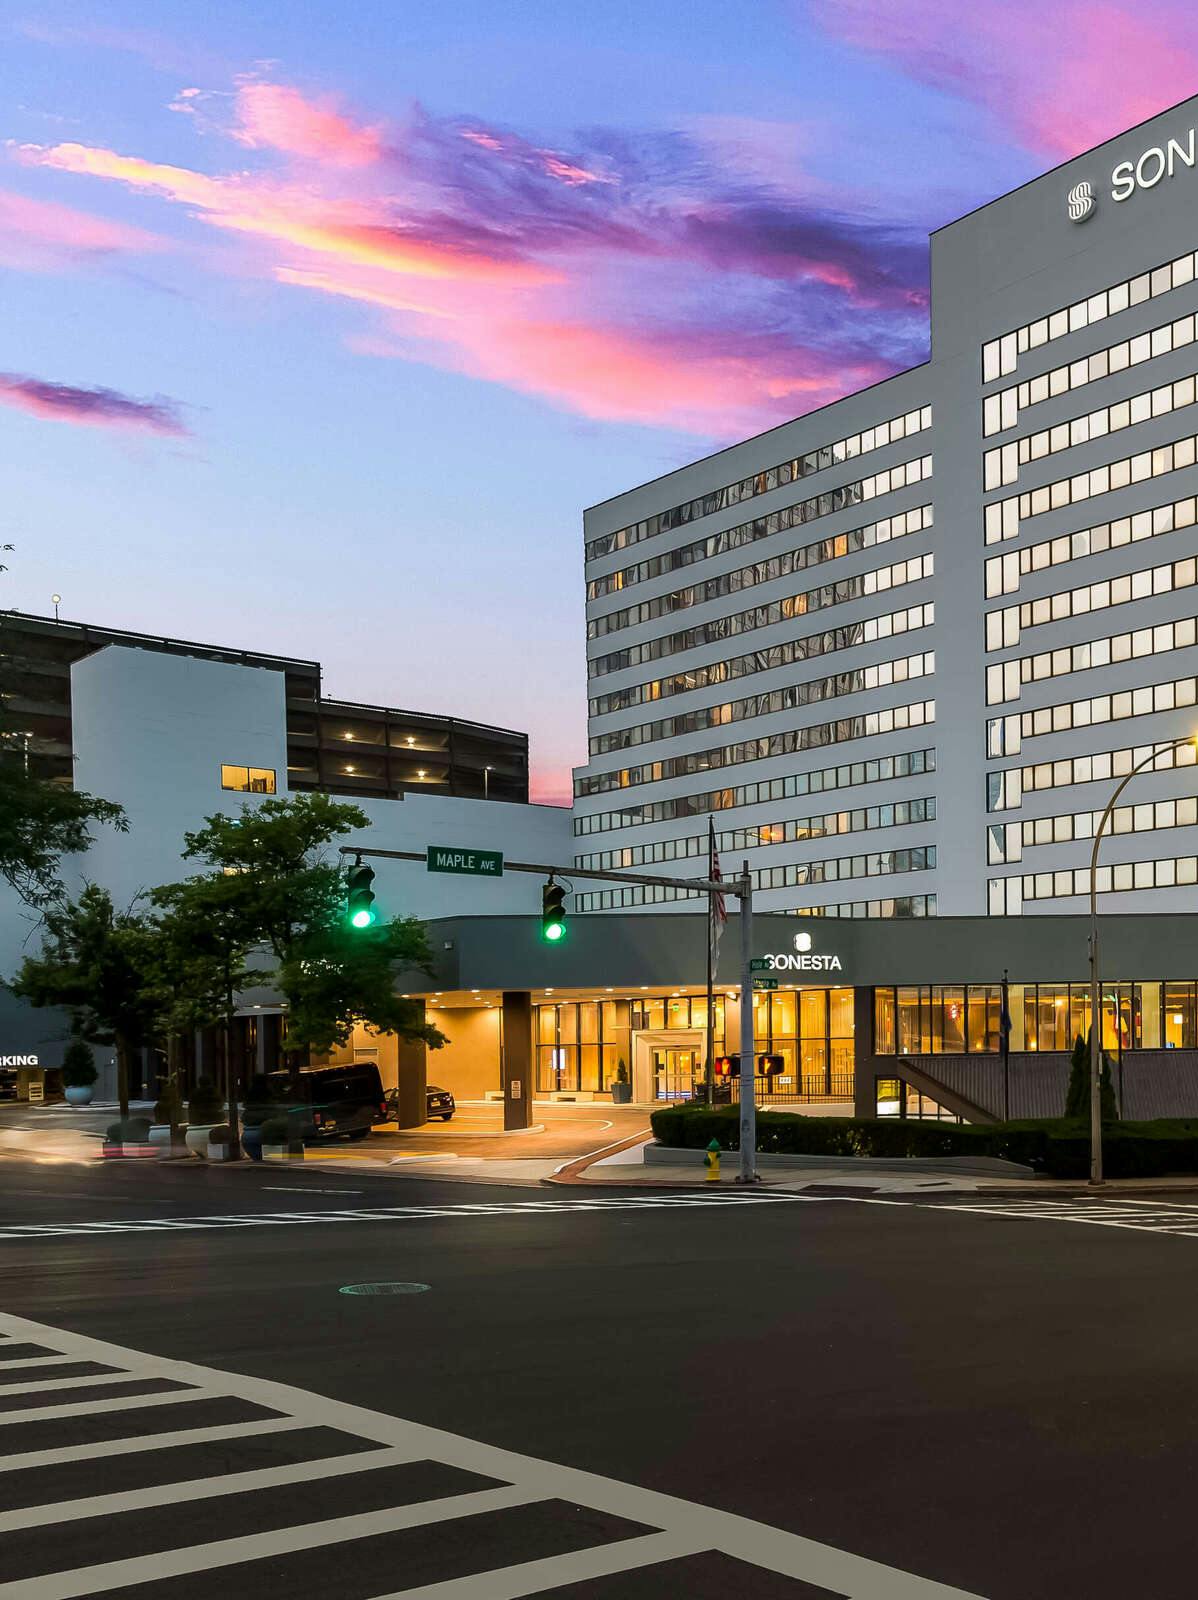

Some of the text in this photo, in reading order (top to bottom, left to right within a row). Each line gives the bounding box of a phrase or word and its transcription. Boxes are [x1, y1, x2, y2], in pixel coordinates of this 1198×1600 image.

[436, 852, 496, 871] MAPLE AVE
[0, 1055, 39, 1066] KING
